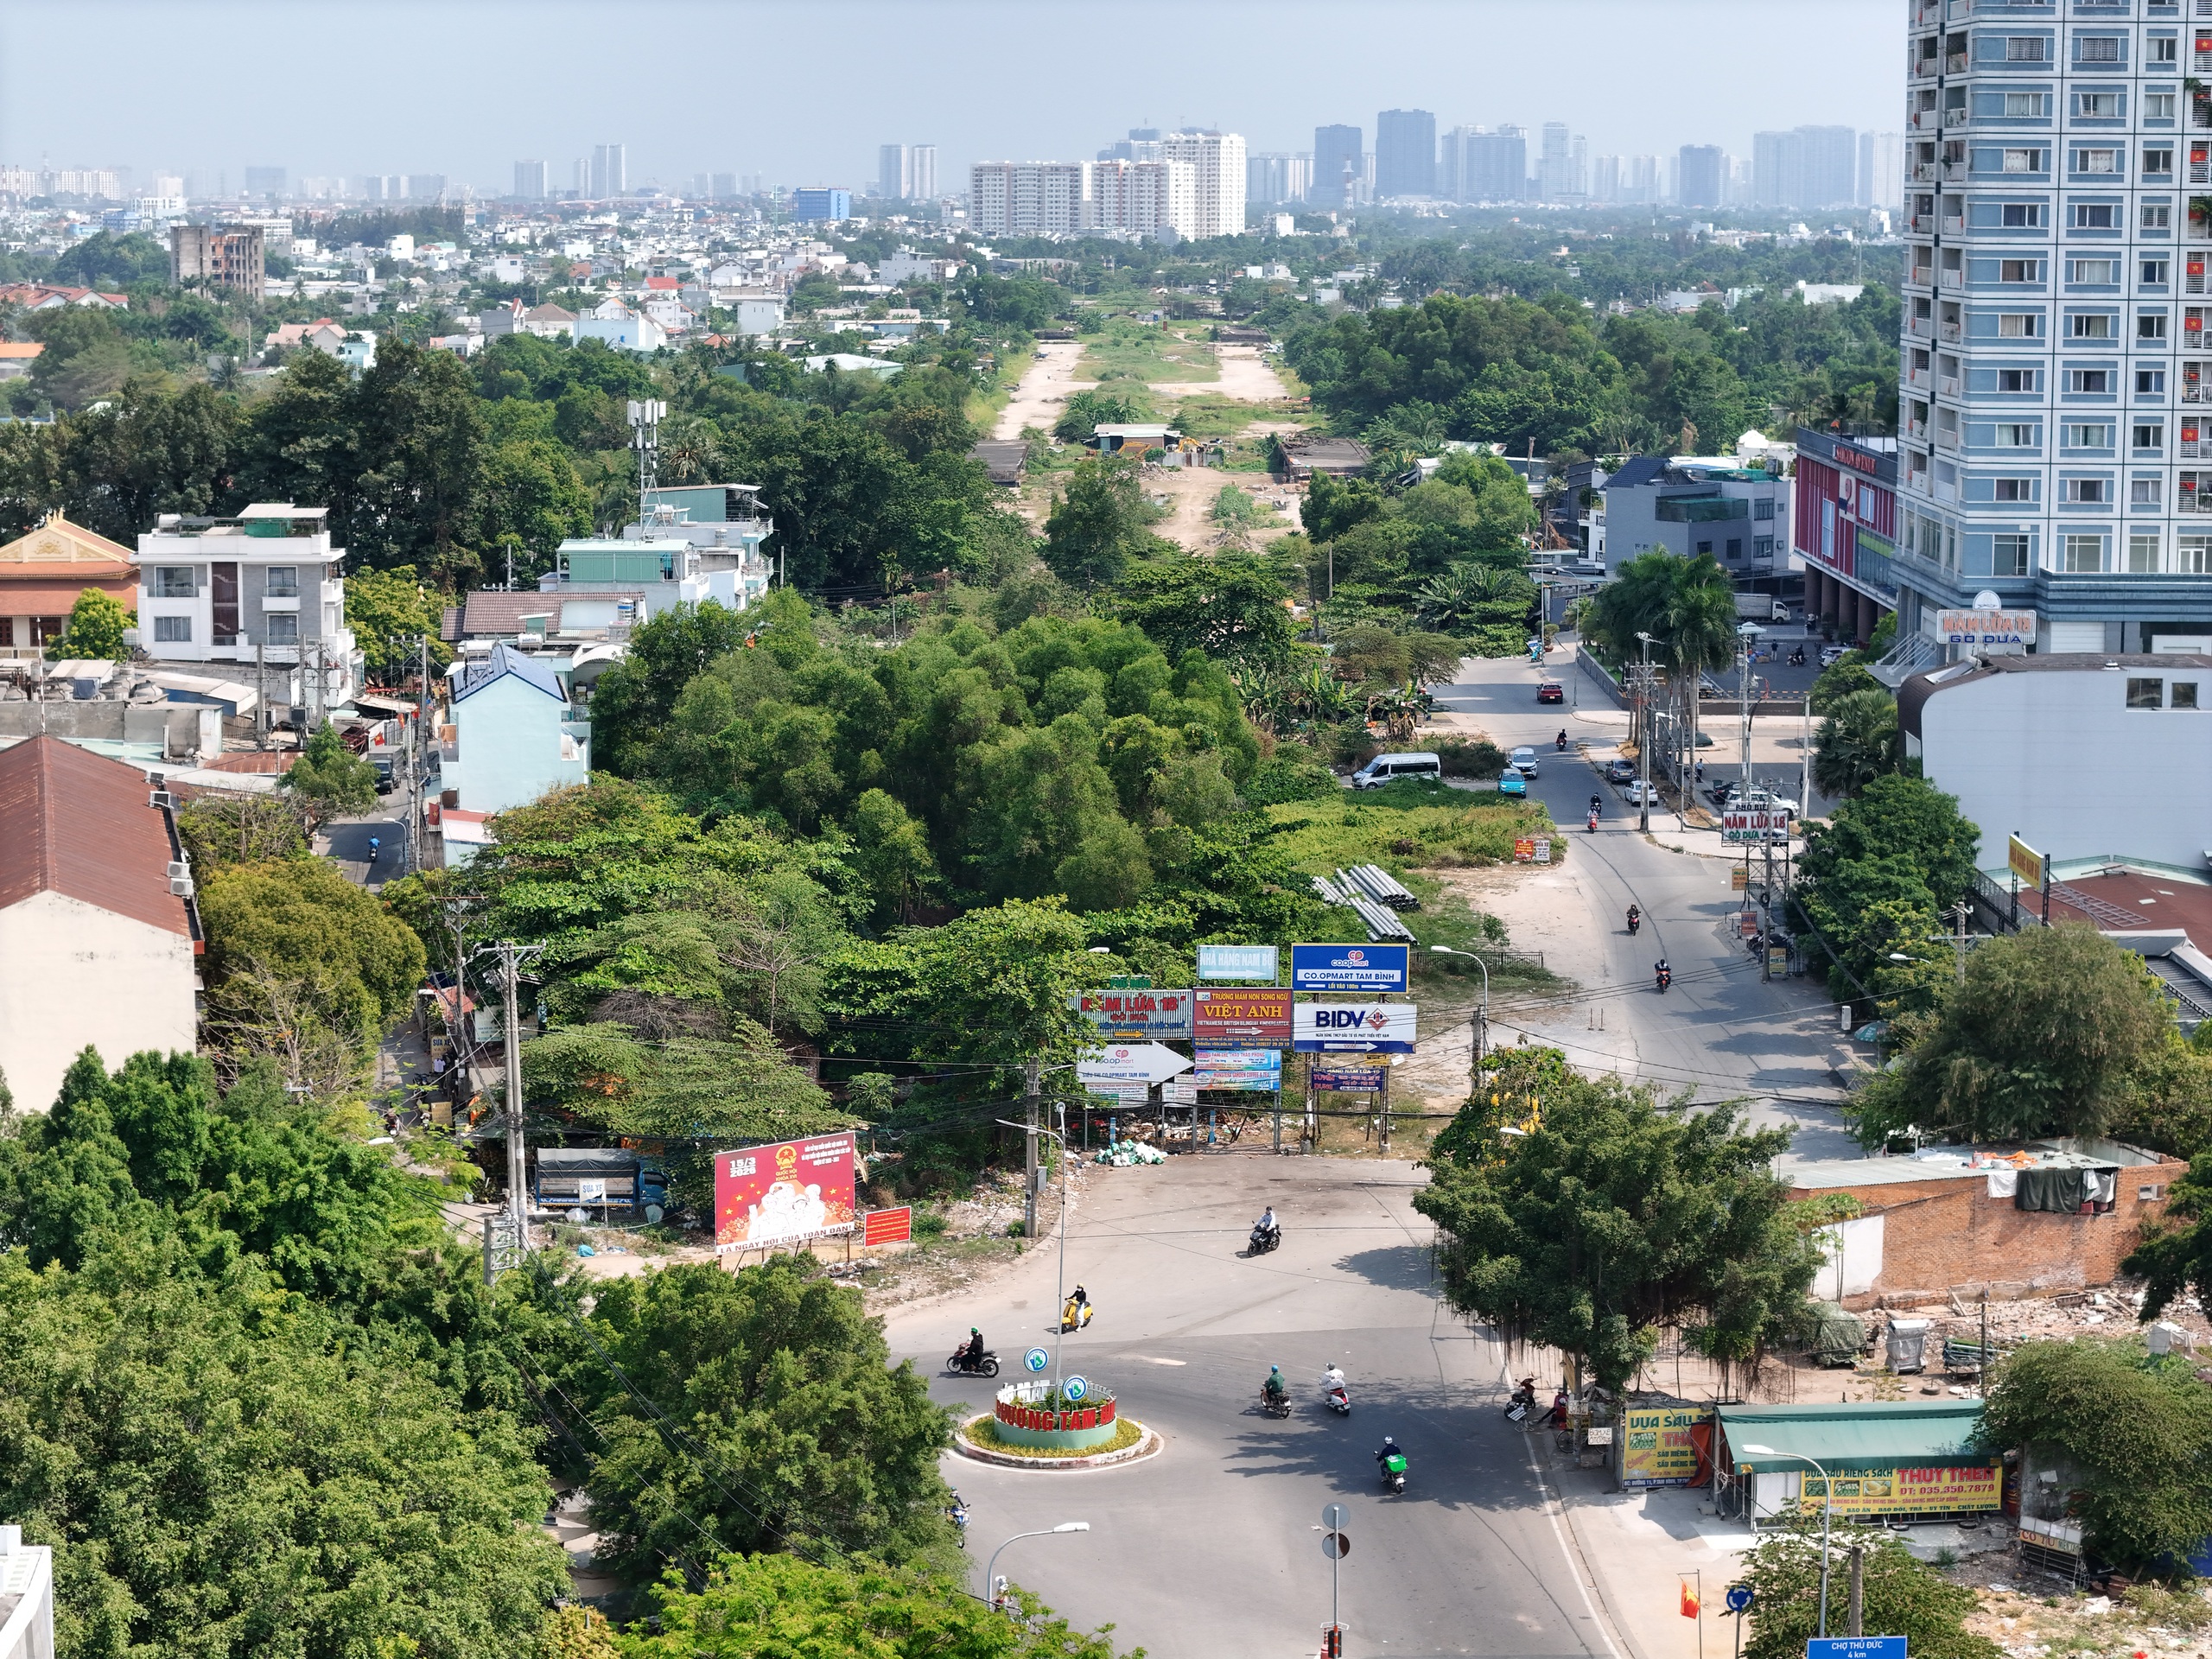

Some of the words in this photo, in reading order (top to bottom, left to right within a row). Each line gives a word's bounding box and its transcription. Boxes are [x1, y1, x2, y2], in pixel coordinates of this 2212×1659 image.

[2016, 617, 2031, 632] 18
[1950, 633, 1975, 644] GÒ
[1984, 634, 2022, 644] DƯA
[1724, 813, 1747, 830] NĂM
[1773, 816, 1786, 830] 18
[1728, 830, 1741, 840] GÒ
[1742, 830, 1760, 840] DƯA
[1242, 953, 1261, 966] NAM
[1375, 971, 1395, 981] BÌNH
[1125, 992, 1156, 1011] LỬA
[1160, 997, 1178, 1011] 18
[1211, 992, 1234, 1001] TRƯỜNG
[1204, 1003, 1243, 1019] VIỆT
[1247, 1006, 1283, 1018] ANH
[1315, 1010, 1366, 1028] BIDV
[729, 1157, 756, 1168] 15/3
[729, 1167, 756, 1178] 2026
[595, 1184, 603, 1192] XE
[1059, 1408, 1096, 1432] TAM
[1919, 1484, 1994, 1495] 035.350.7879
[1831, 1642, 1847, 1650] CHỢ
[1849, 1640, 1866, 1649] THỦ
[1866, 1640, 1883, 1649] ĐỨC
